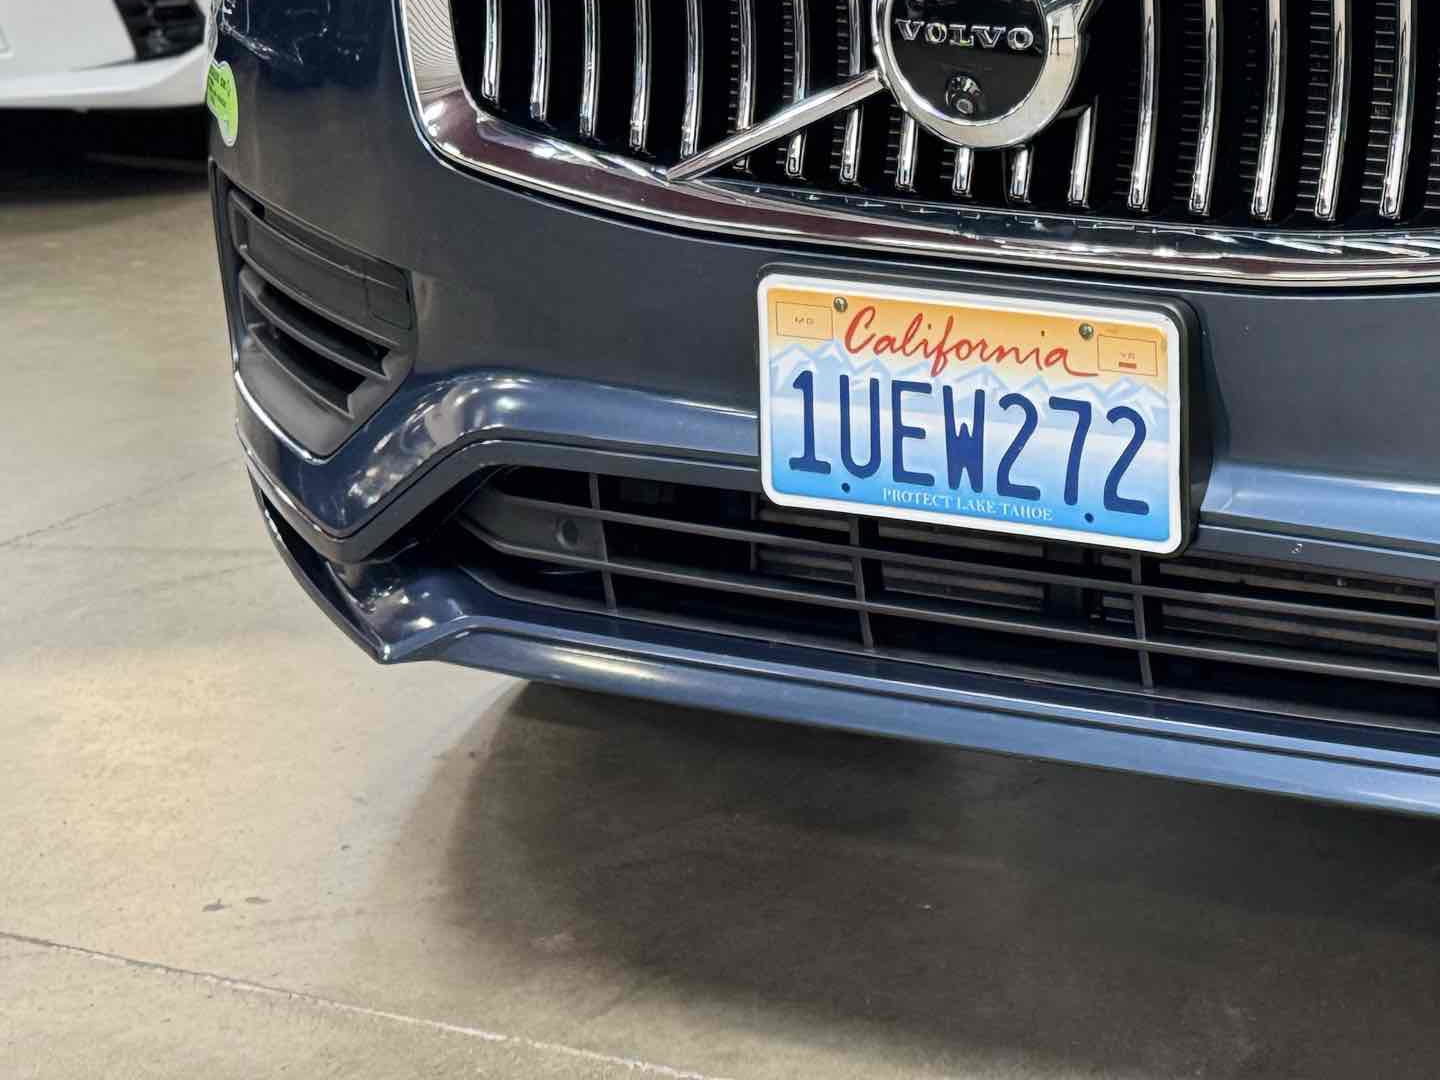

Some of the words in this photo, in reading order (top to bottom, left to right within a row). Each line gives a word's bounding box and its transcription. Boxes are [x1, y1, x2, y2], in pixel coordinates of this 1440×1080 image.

[895, 18, 1034, 51] VOLVO
[843, 305, 1100, 377] California
[788, 370, 1150, 515] 1UEW272
[882, 487, 954, 509] PROTECT
[957, 496, 998, 515] LAKE
[1002, 500, 1053, 522] TAHOE
